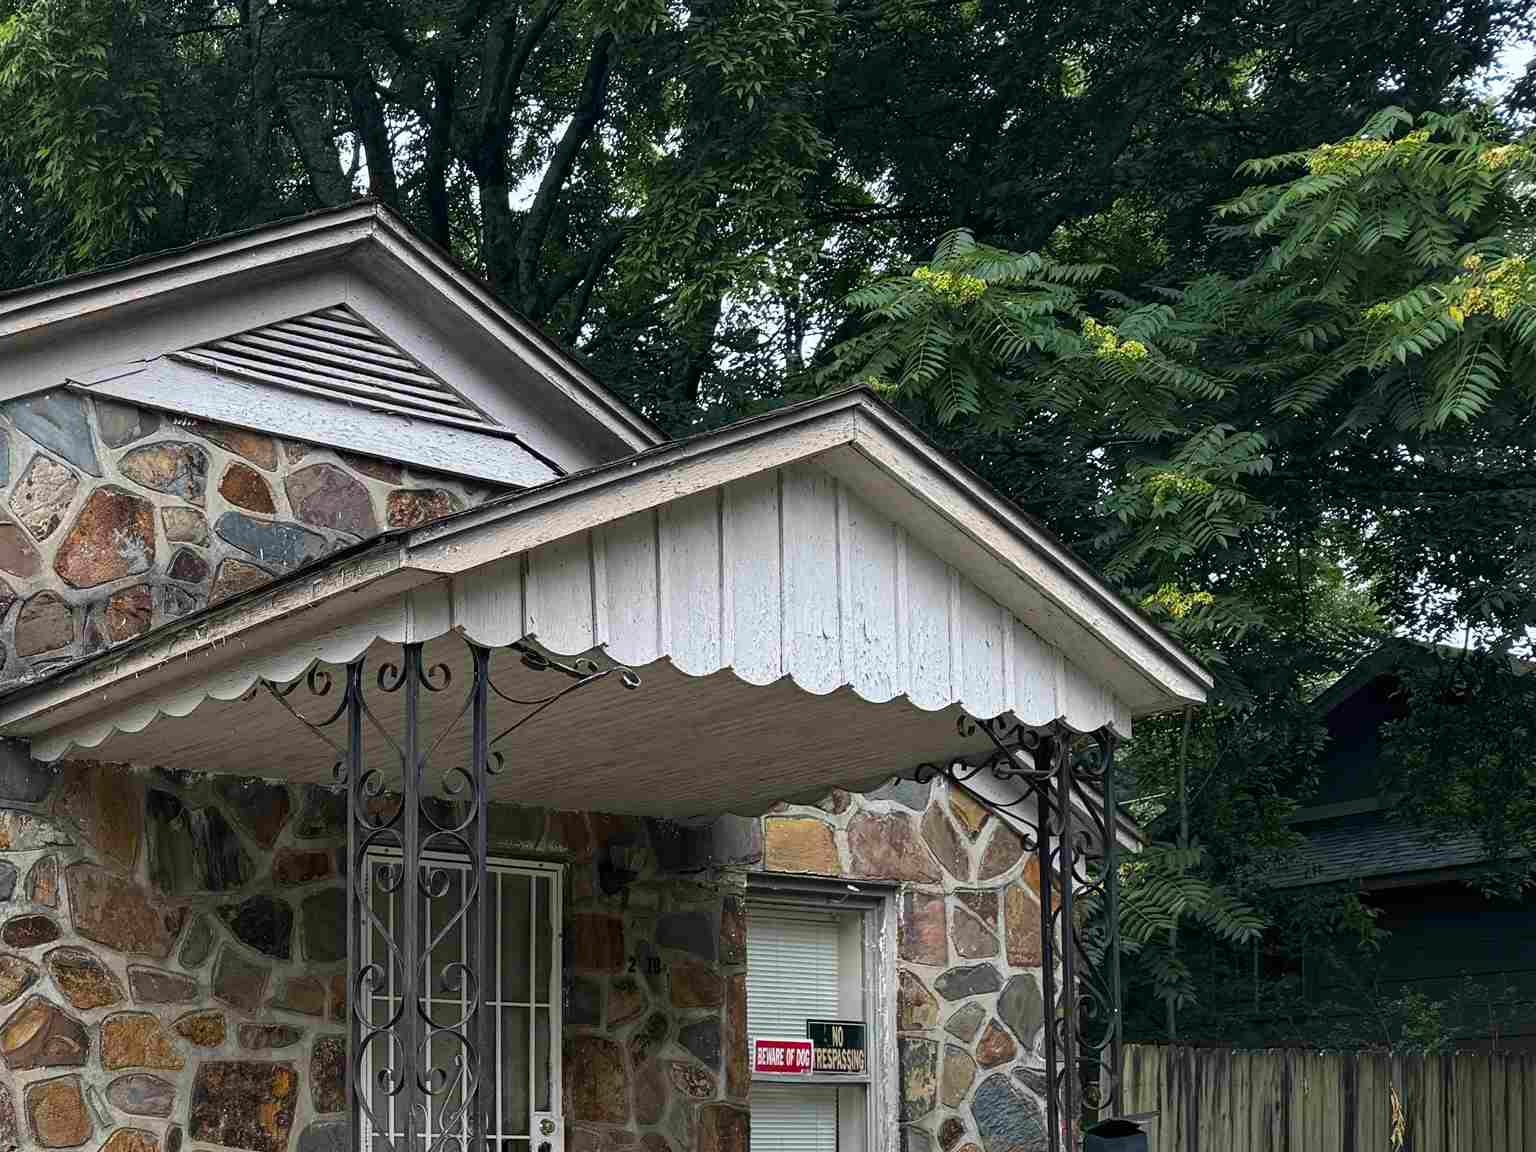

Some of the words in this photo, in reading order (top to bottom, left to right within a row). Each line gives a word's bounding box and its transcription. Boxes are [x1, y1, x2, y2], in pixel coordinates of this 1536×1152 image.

[831, 1025, 844, 1048] NO
[757, 1048, 784, 1066] BEWARE
[786, 1048, 795, 1067] OF
[796, 1048, 810, 1067] DOG
